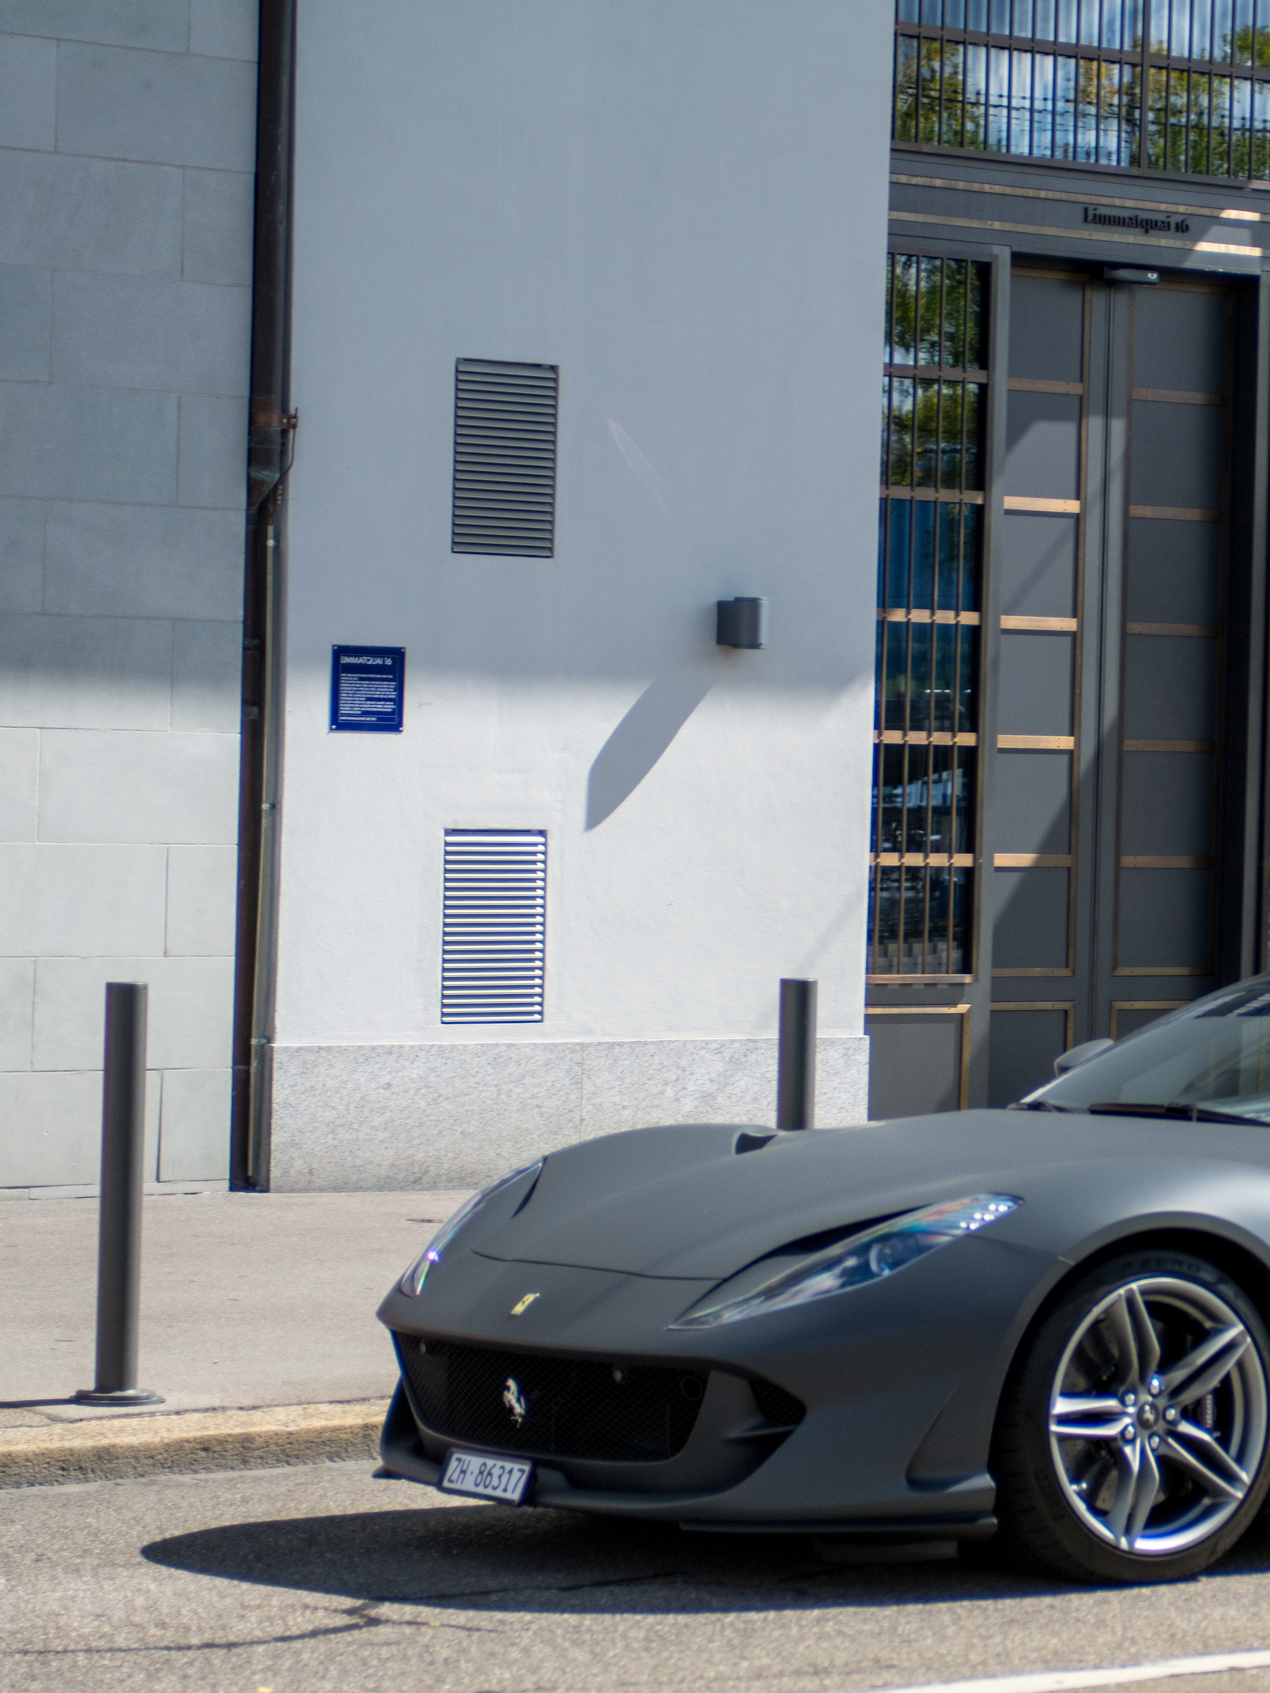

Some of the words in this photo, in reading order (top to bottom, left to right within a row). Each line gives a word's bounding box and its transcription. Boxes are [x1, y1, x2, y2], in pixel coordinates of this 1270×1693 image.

[1083, 207, 1172, 234] Limmatquai
[1174, 217, 1190, 234] 16
[474, 1461, 526, 1495] 86317
